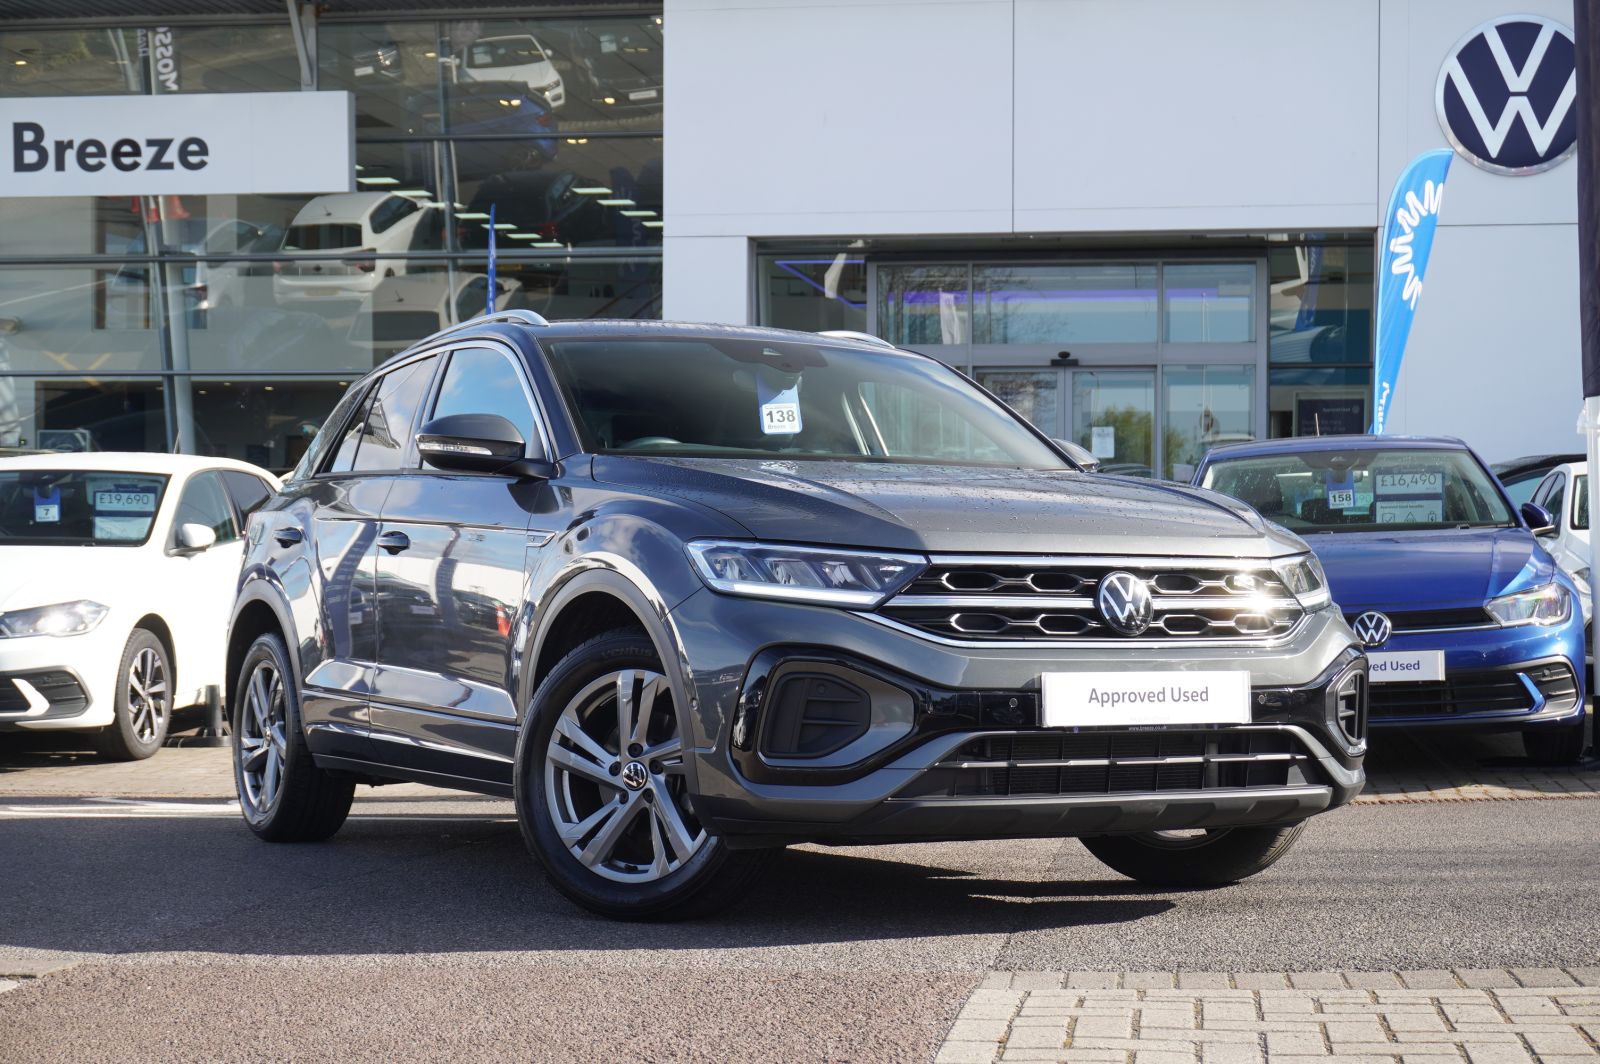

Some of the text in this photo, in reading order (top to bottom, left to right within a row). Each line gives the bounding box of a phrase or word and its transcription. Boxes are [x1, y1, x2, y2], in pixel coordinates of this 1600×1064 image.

[12, 121, 209, 173] Breeze
[766, 409, 796, 423] 138
[1380, 473, 1437, 489] £16,490
[98, 493, 150, 506] £19,690
[1331, 493, 1352, 503] 158
[43, 508, 50, 516] 7
[1390, 660, 1420, 671] Used
[1088, 686, 1209, 708] Approved Used
